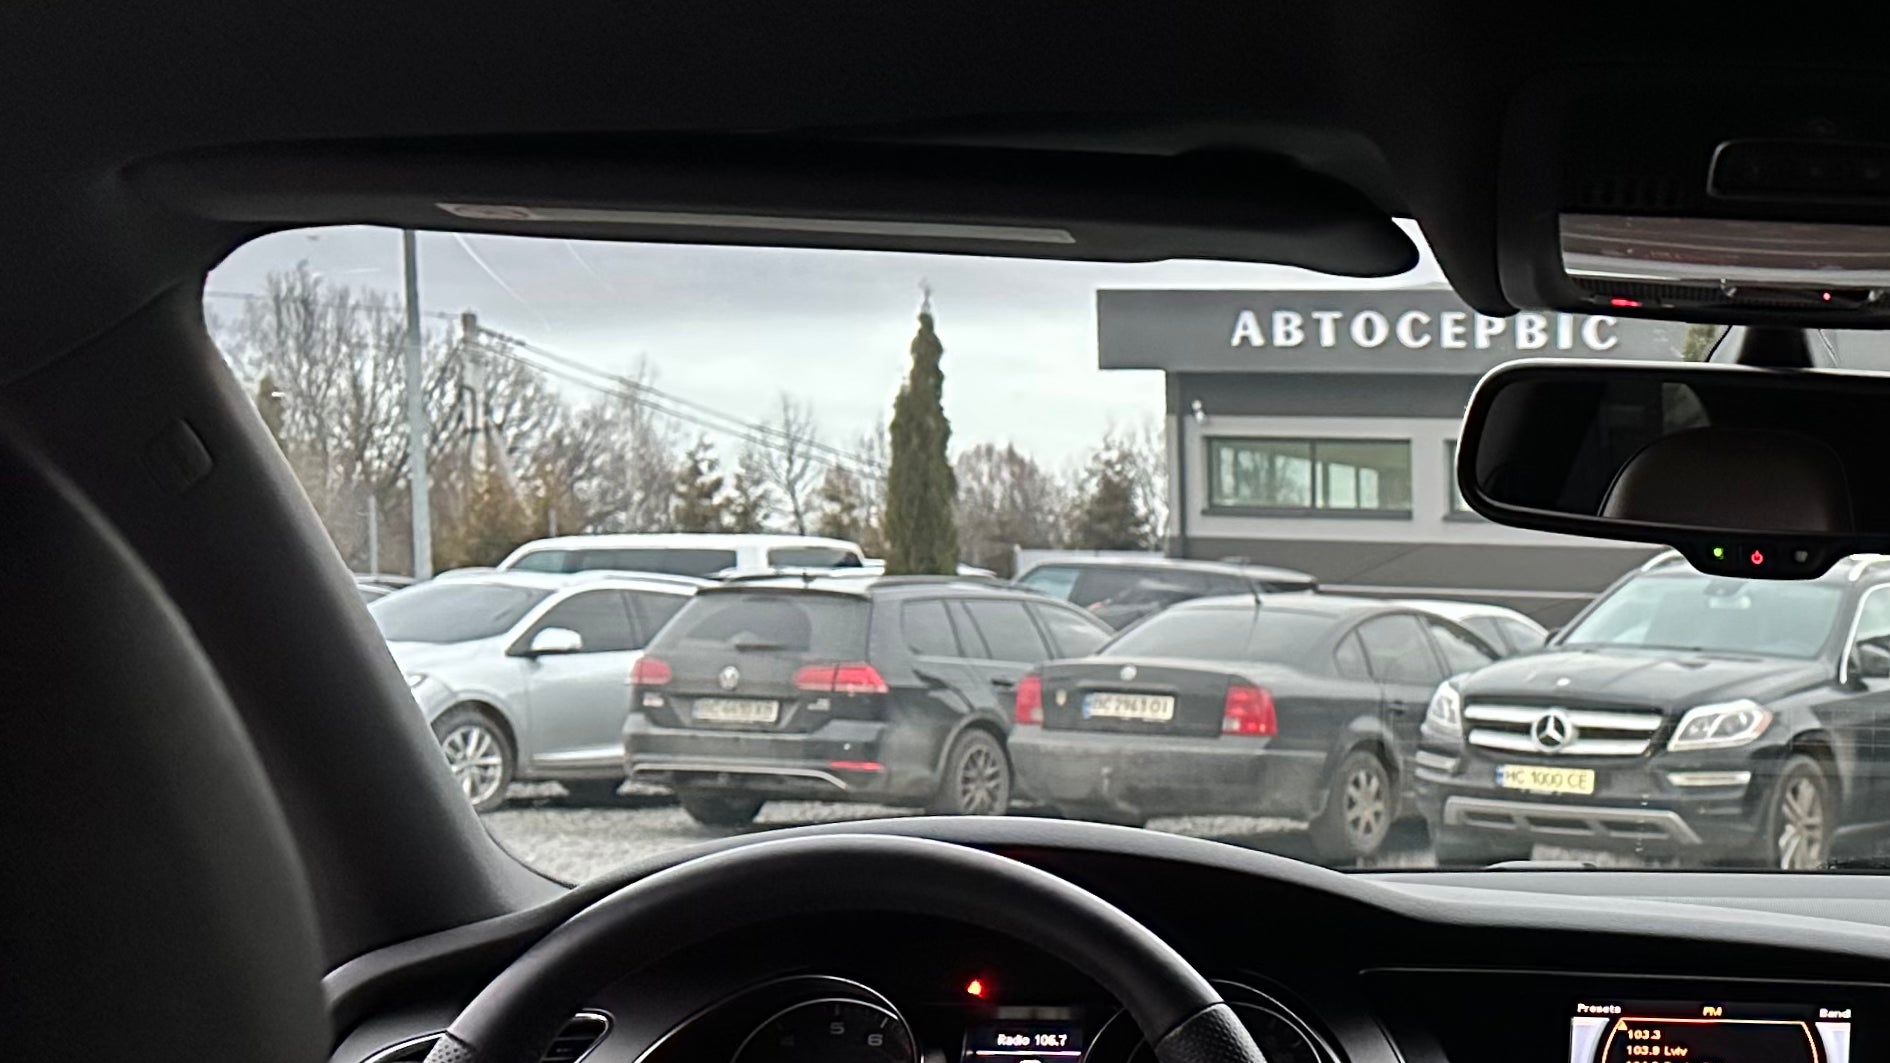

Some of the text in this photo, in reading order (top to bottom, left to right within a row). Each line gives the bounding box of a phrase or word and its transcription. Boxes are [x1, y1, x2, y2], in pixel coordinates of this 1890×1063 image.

[1703, 1006, 1723, 1017] FM
[1819, 1008, 1852, 1019] Band
[829, 1021, 845, 1035] 5
[866, 1033, 883, 1047] 6
[1627, 1029, 1661, 1040] 103.3
[1664, 1046, 1689, 1056] Lviv
